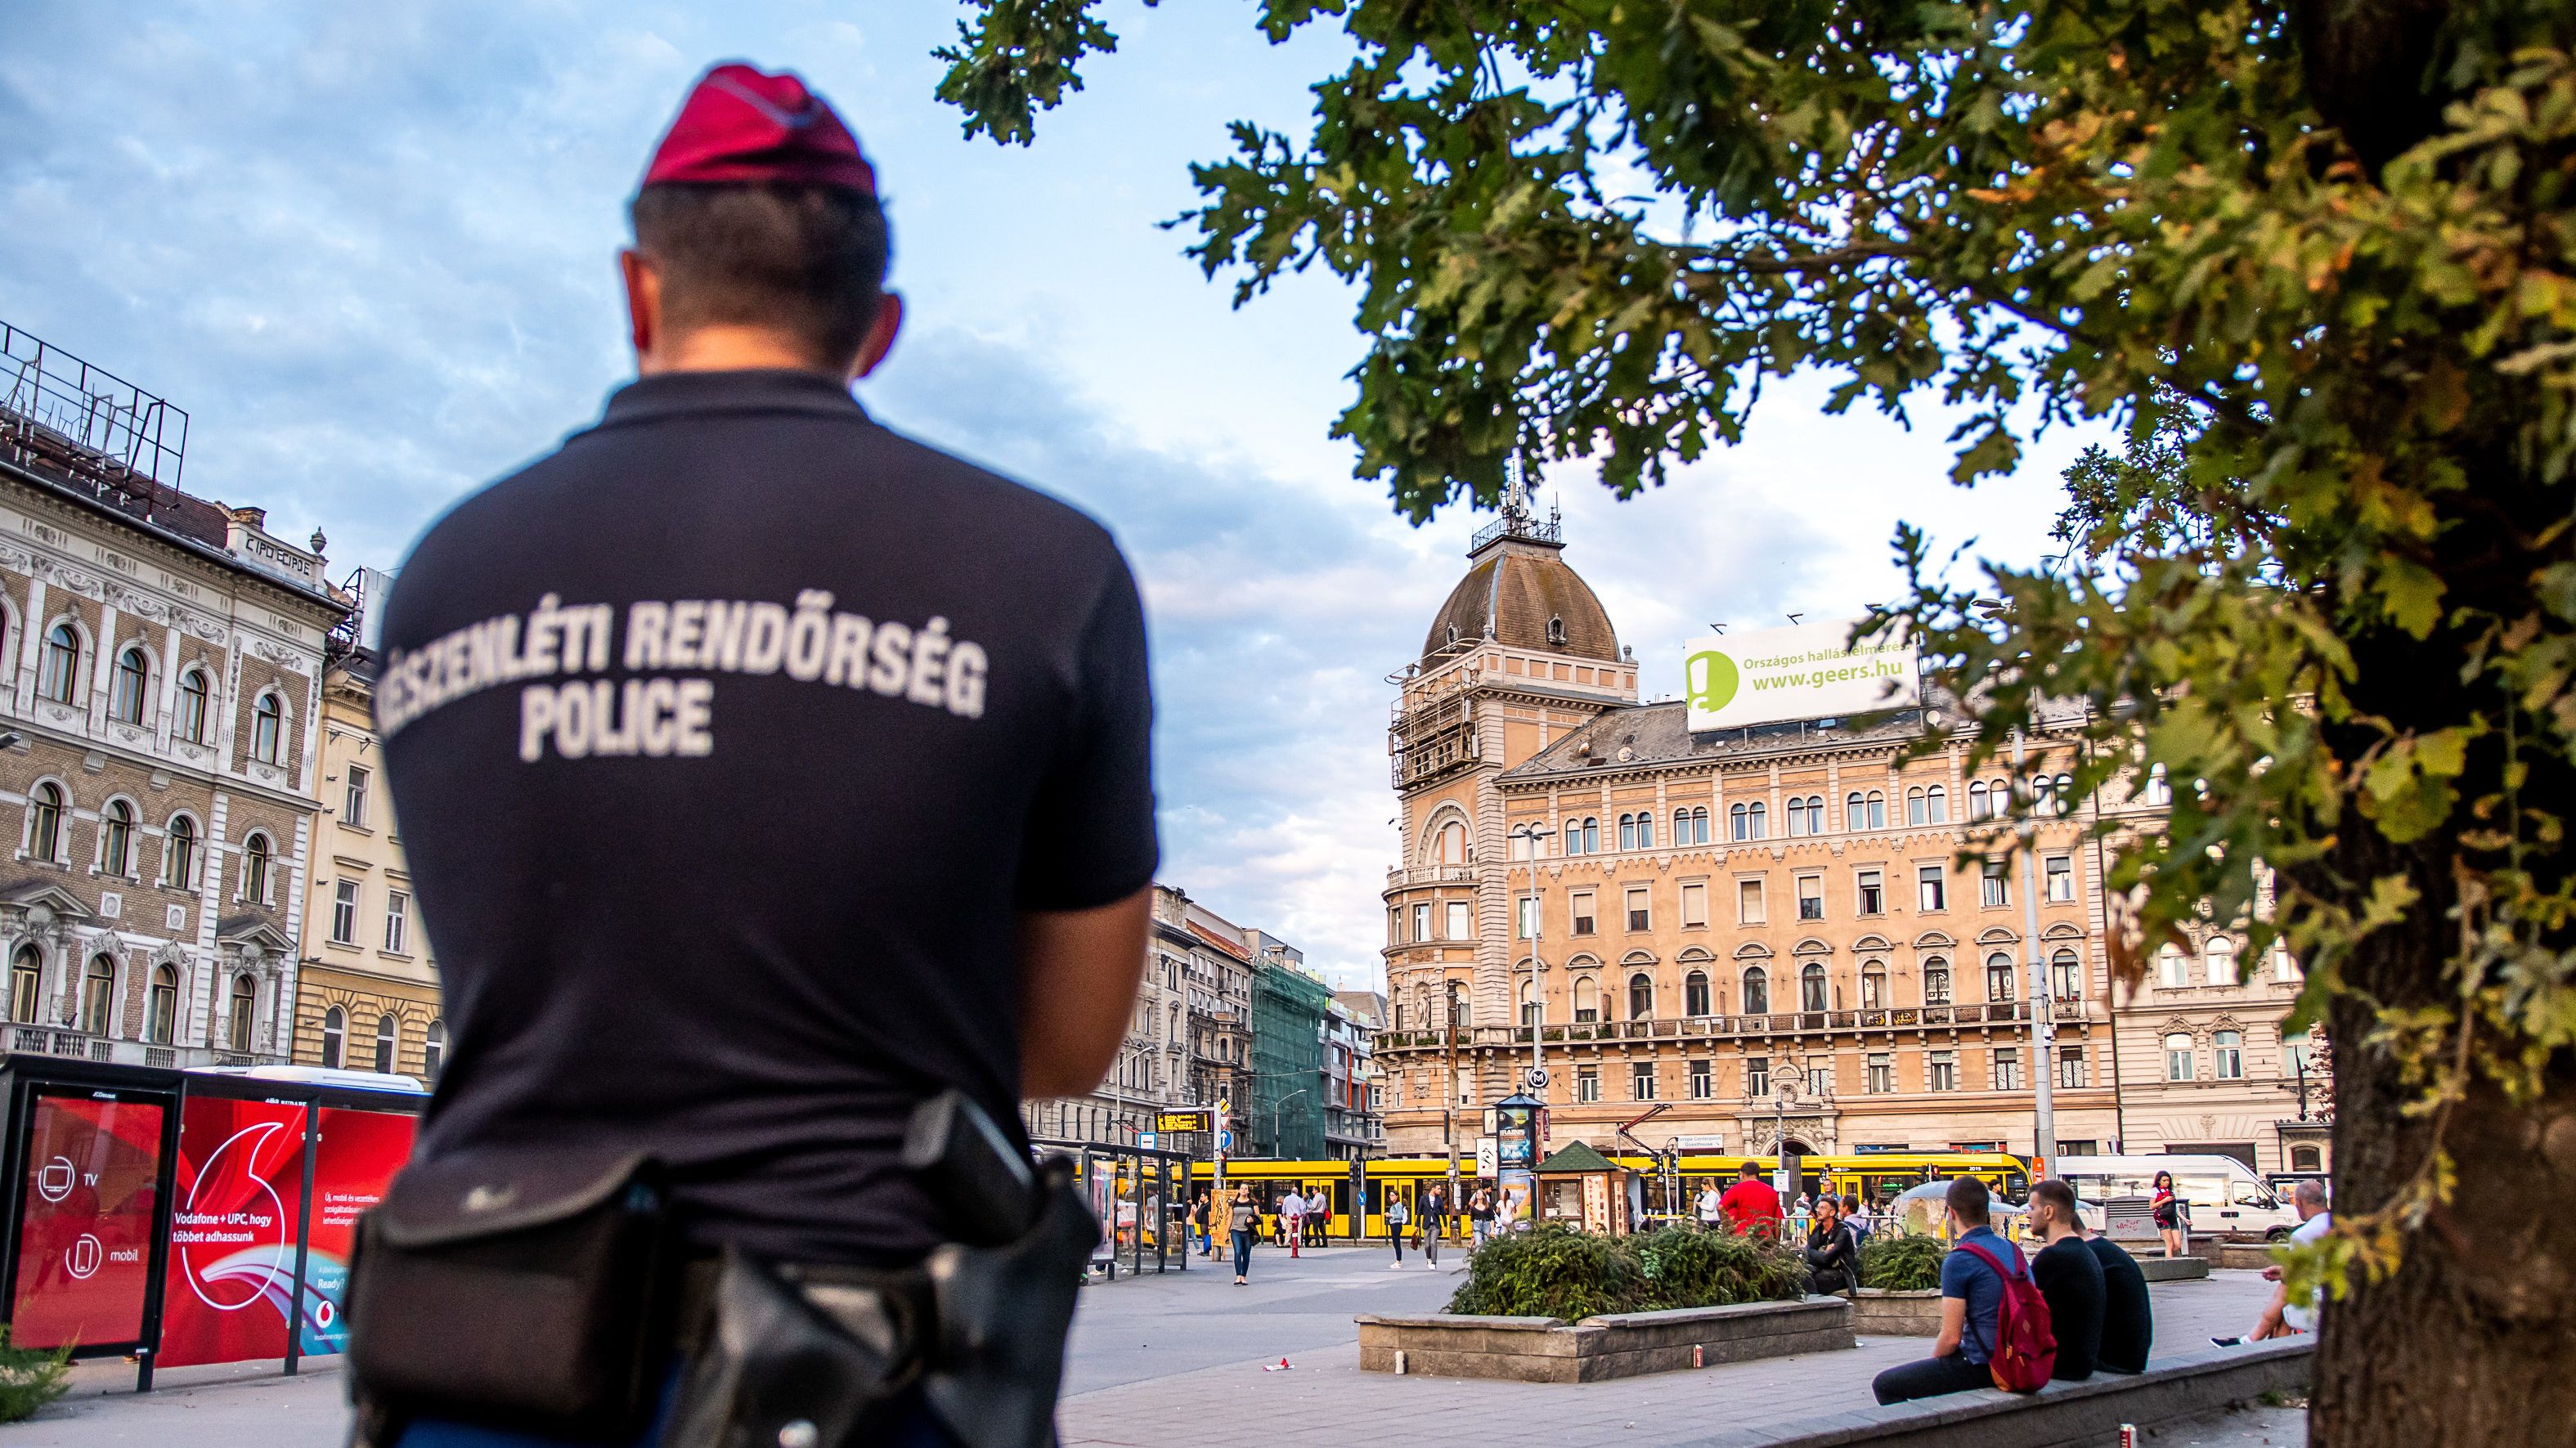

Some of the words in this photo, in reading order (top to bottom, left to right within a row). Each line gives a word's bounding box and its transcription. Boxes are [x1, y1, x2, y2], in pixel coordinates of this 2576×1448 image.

[624, 588, 988, 719] RENDŐRSÉG
[1744, 655, 1804, 670] Országos
[1752, 659, 1903, 691] www.geers.hu
[519, 678, 714, 762] POLICE
[1533, 1073, 1544, 1083] M
[83, 1173, 98, 1186] TV
[174, 1212, 218, 1225] Vodafone
[220, 1214, 226, 1223] +
[227, 1213, 248, 1226] UPC,
[249, 1213, 272, 1227] hogy
[173, 1231, 204, 1242] többet
[205, 1230, 254, 1242] adhassunk
[110, 1249, 138, 1262] mobil
[317, 1277, 345, 1290] Ready?
